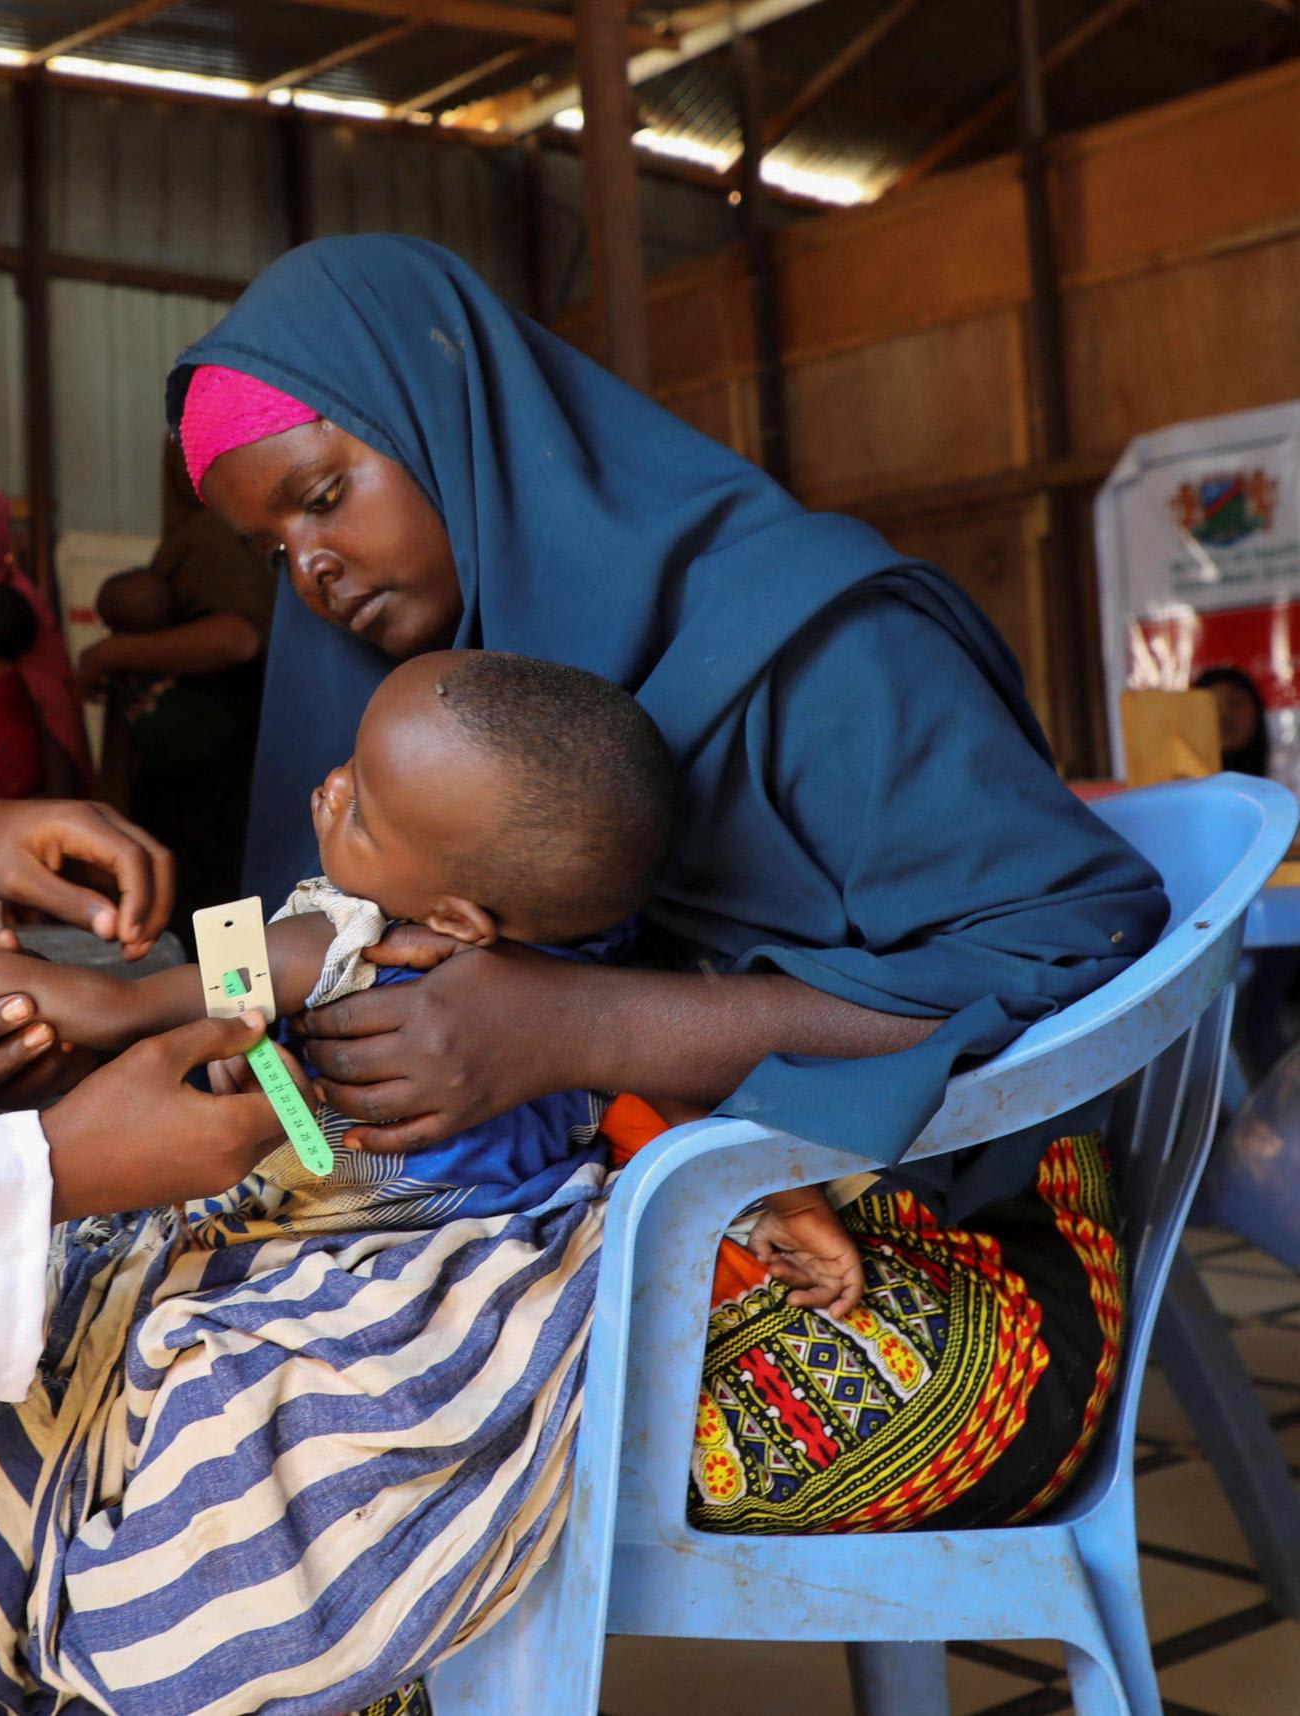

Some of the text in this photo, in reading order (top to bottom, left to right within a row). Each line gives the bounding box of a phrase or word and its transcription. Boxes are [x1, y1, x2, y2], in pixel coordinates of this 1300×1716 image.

[225, 984, 236, 994] 14
[237, 1000, 245, 1012] cm
[256, 1049, 318, 1155] 18 19 20 21 22 23 24 25 26
